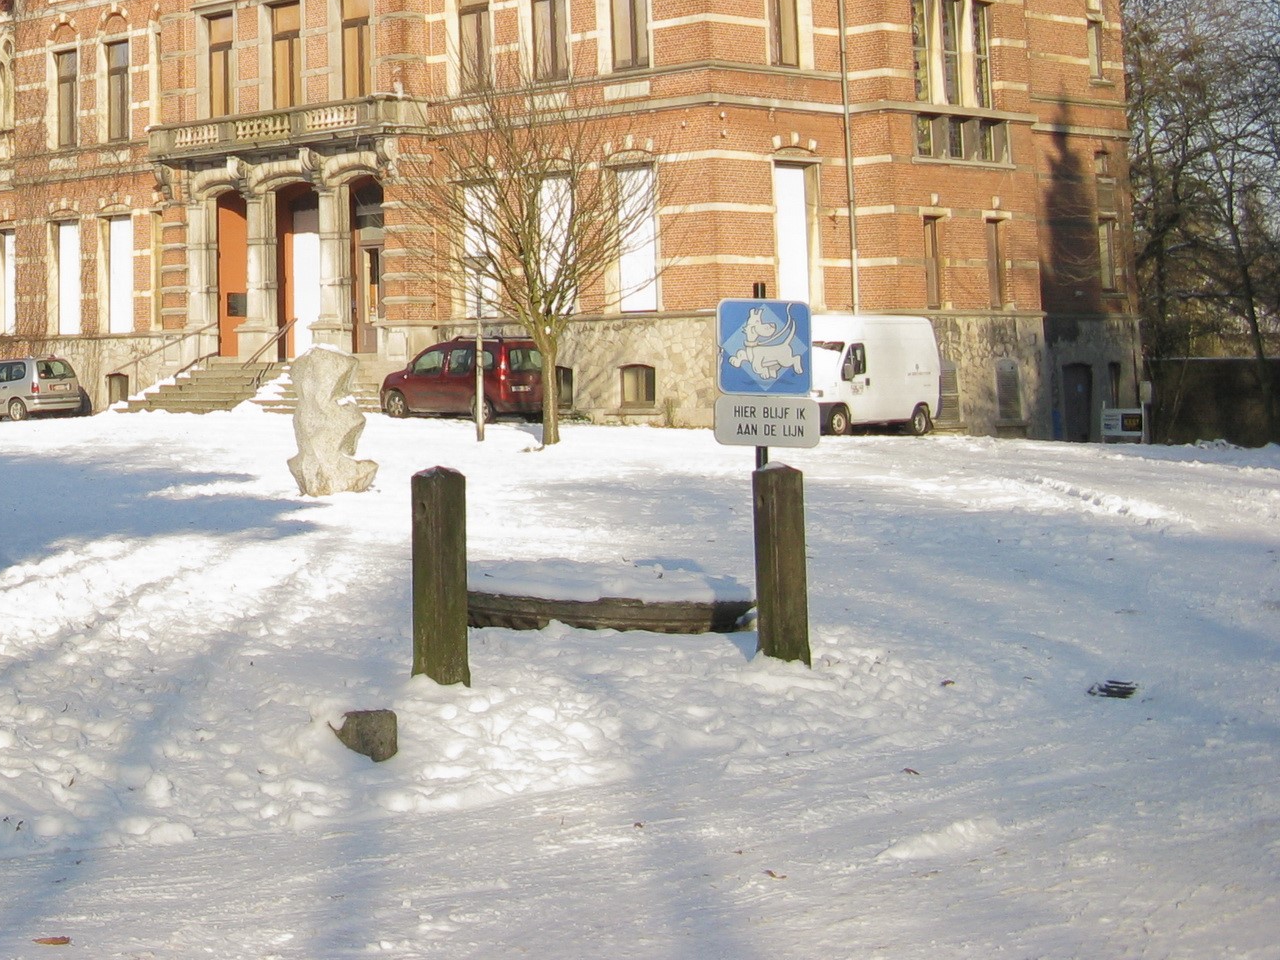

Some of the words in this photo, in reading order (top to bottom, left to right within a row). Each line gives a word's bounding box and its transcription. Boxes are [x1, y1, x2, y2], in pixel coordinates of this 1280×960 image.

[733, 405, 756, 418] HIER
[762, 406, 790, 419] BLIJF
[796, 408, 806, 420] IK
[736, 423, 758, 436] AAN
[763, 424, 777, 436] DE
[782, 425, 804, 438] LIJN
